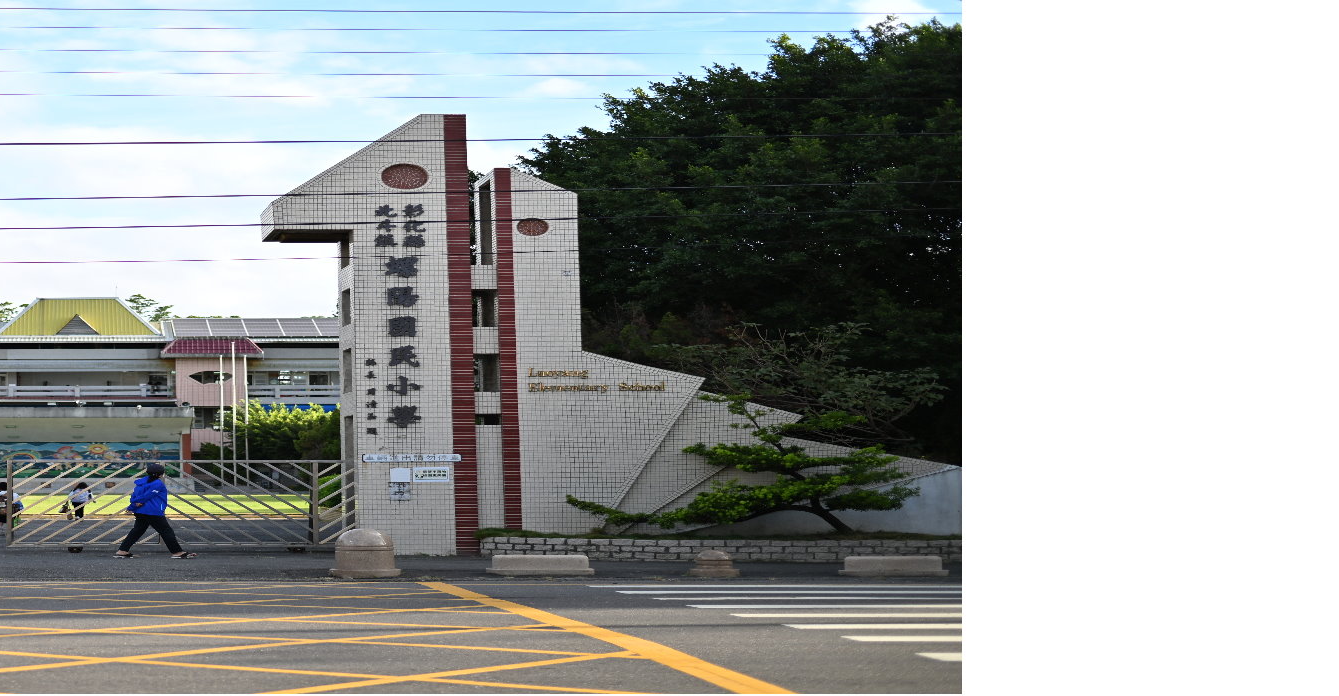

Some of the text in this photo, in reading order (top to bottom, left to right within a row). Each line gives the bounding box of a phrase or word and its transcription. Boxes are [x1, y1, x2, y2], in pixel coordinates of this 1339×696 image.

[374, 204, 398, 247] 北斗鎮
[402, 203, 426, 248] 彰化縣
[385, 256, 422, 428] 螺陽國民小學
[527, 381, 666, 393] Elementary School
